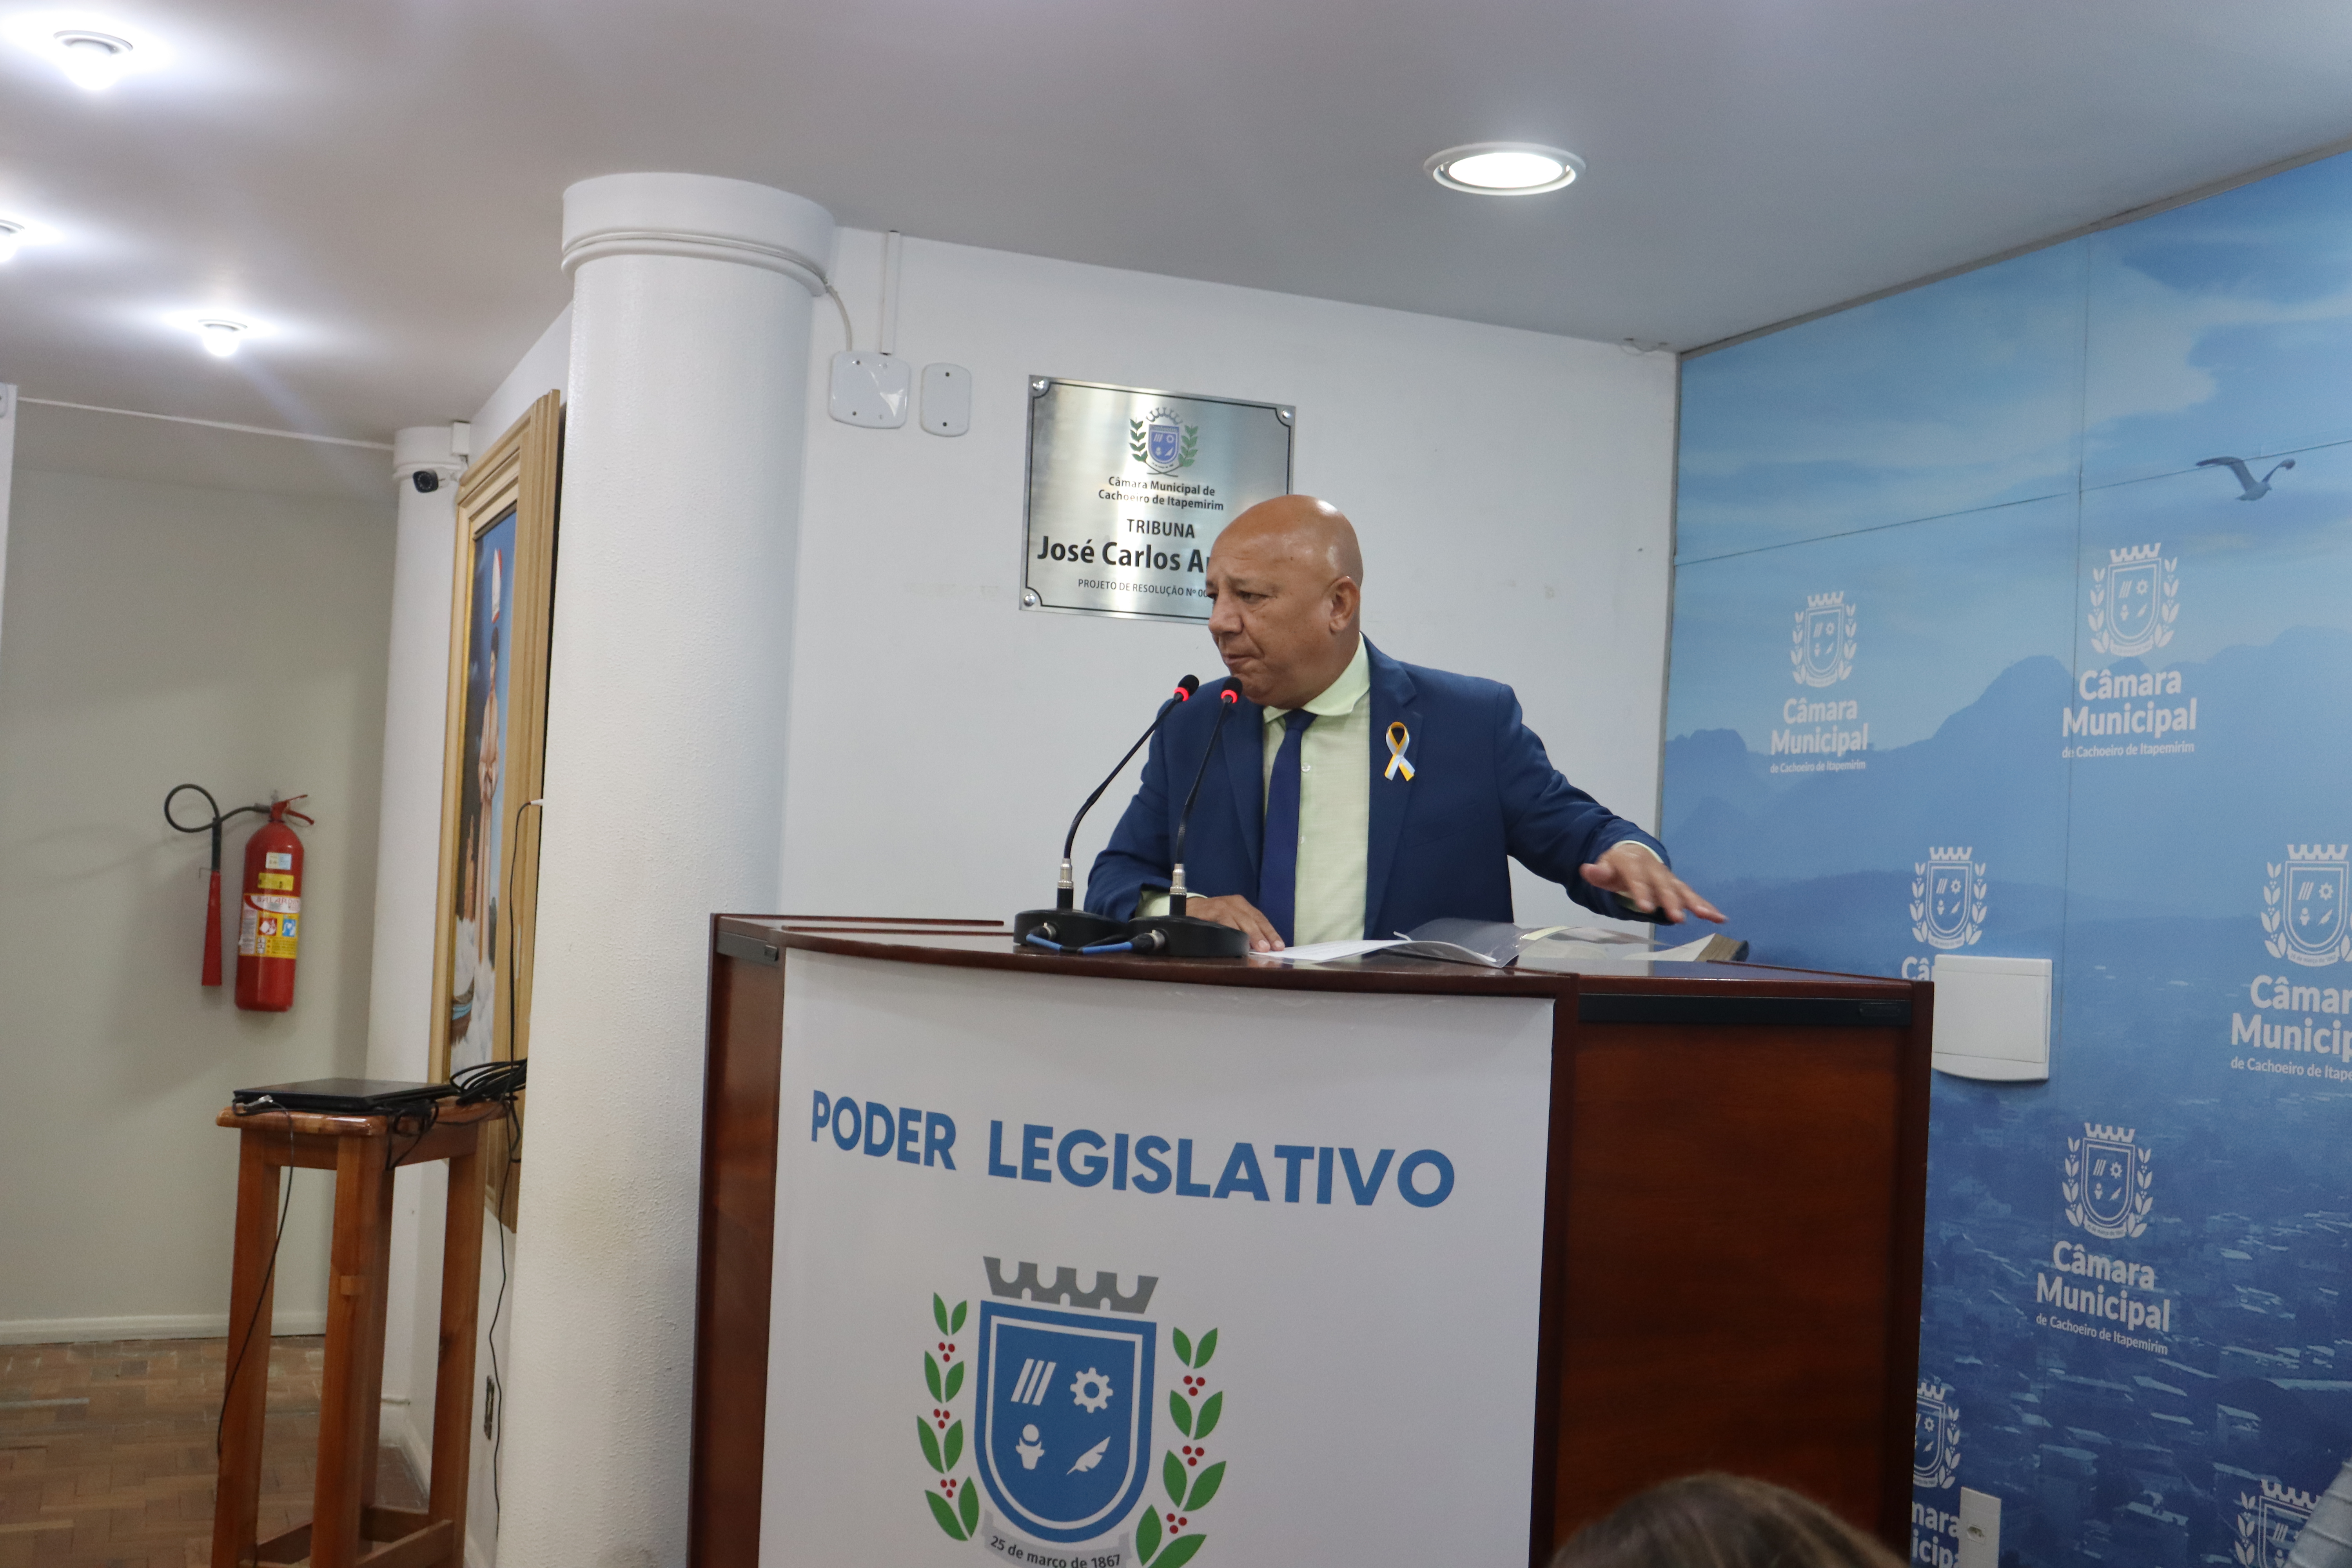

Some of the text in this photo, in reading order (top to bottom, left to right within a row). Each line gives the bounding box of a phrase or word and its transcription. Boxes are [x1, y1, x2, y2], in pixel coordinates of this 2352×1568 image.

[1099, 490, 1223, 511] Cachoeiro de Itapemirim
[1109, 476, 1215, 496] Câmara Municipal de
[1127, 519, 1195, 539] TRIBUNA
[1037, 535, 1094, 563] José
[1102, 542, 1180, 571] Carlos
[1078, 579, 1116, 590] PROJETO
[1119, 582, 1130, 591] DE
[1133, 584, 1184, 597] RESOLUÇÃO
[2079, 669, 2181, 701] Câmara
[1784, 697, 1857, 724] Câmara
[2062, 697, 2197, 739] Municipal
[1771, 722, 1869, 757] Municipal
[2062, 740, 2194, 758] de Cachoeiro de Itapemirim
[1770, 759, 1866, 773] de Cachoeiro de Itapemirim
[1902, 956, 1929, 980] Câ
[2250, 975, 2352, 1014] Câmar
[2231, 1013, 2352, 1063] Municip
[2231, 1056, 2245, 1069] de
[2247, 1058, 2305, 1076] Cachoeiro
[2307, 1064, 2322, 1078] de
[811, 1090, 1455, 1208] PODER LEGISLATIVO
[2053, 1240, 2155, 1290] Câmara
[2036, 1272, 2171, 1332] Municipal
[2036, 1312, 2168, 1355] de Cachoeiro de Itapemirim
[991, 1535, 1120, 1568] 25 de março de 1867
